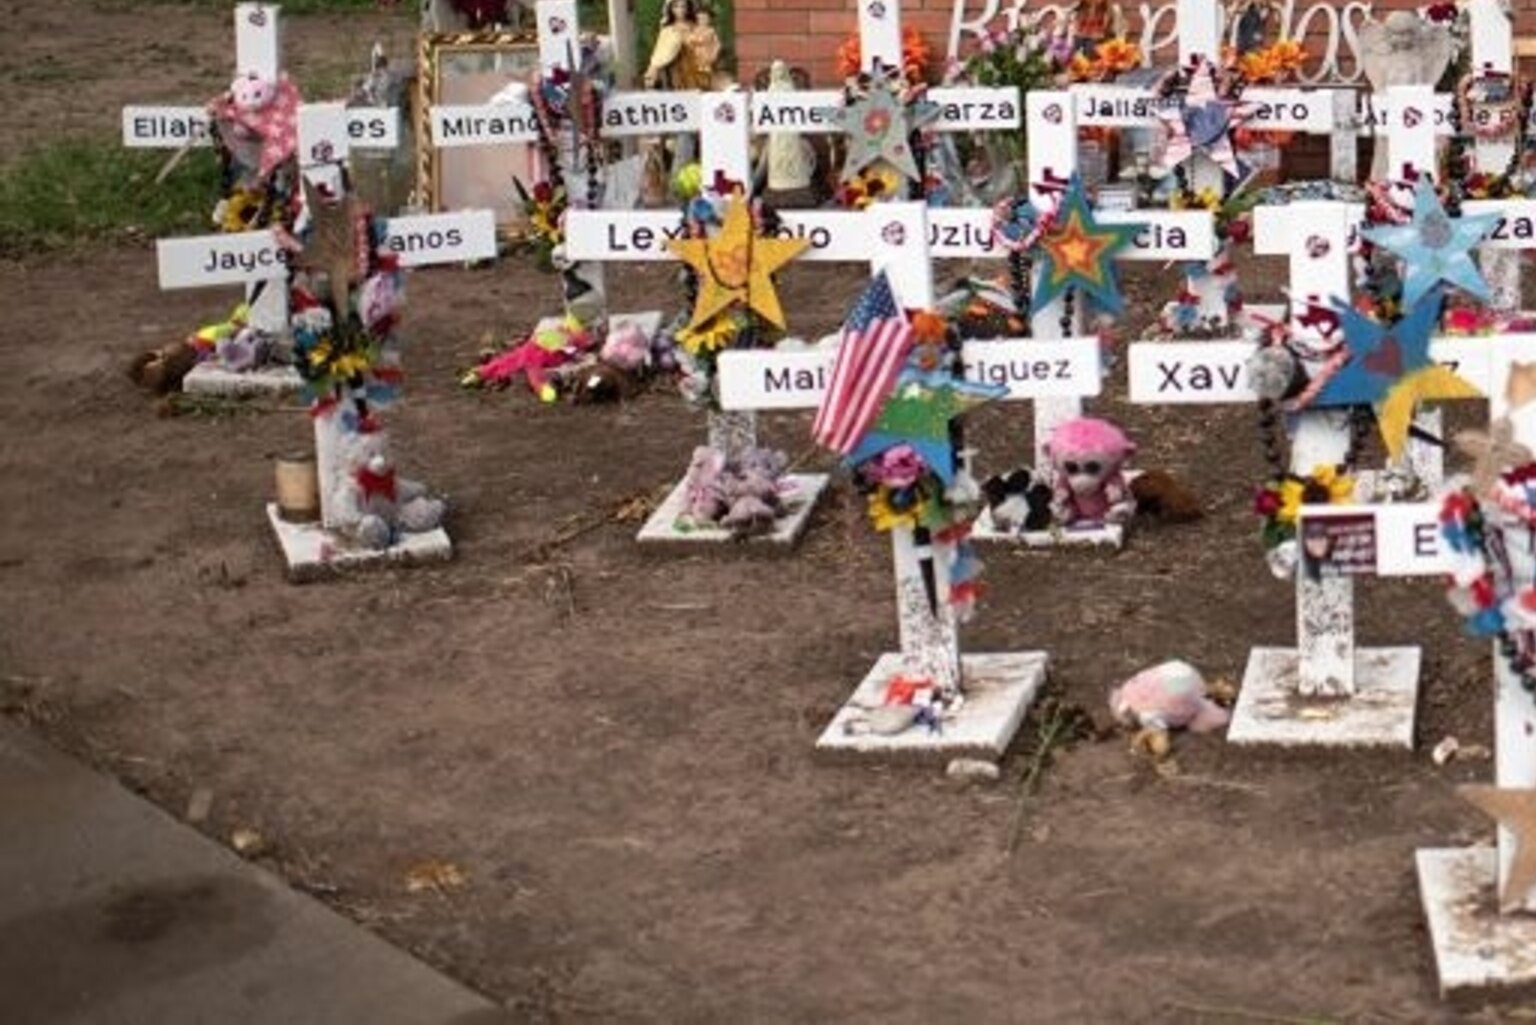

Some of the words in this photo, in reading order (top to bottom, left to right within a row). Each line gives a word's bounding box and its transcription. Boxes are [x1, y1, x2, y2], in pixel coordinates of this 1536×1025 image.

[605, 102, 689, 127] athis
[758, 105, 826, 124] Ame
[943, 100, 1016, 121] arza
[388, 226, 464, 252] anos
[607, 223, 688, 252] Lex
[763, 364, 829, 393] Mai
[963, 357, 1072, 386] riguez
[1156, 360, 1244, 392] Xav
